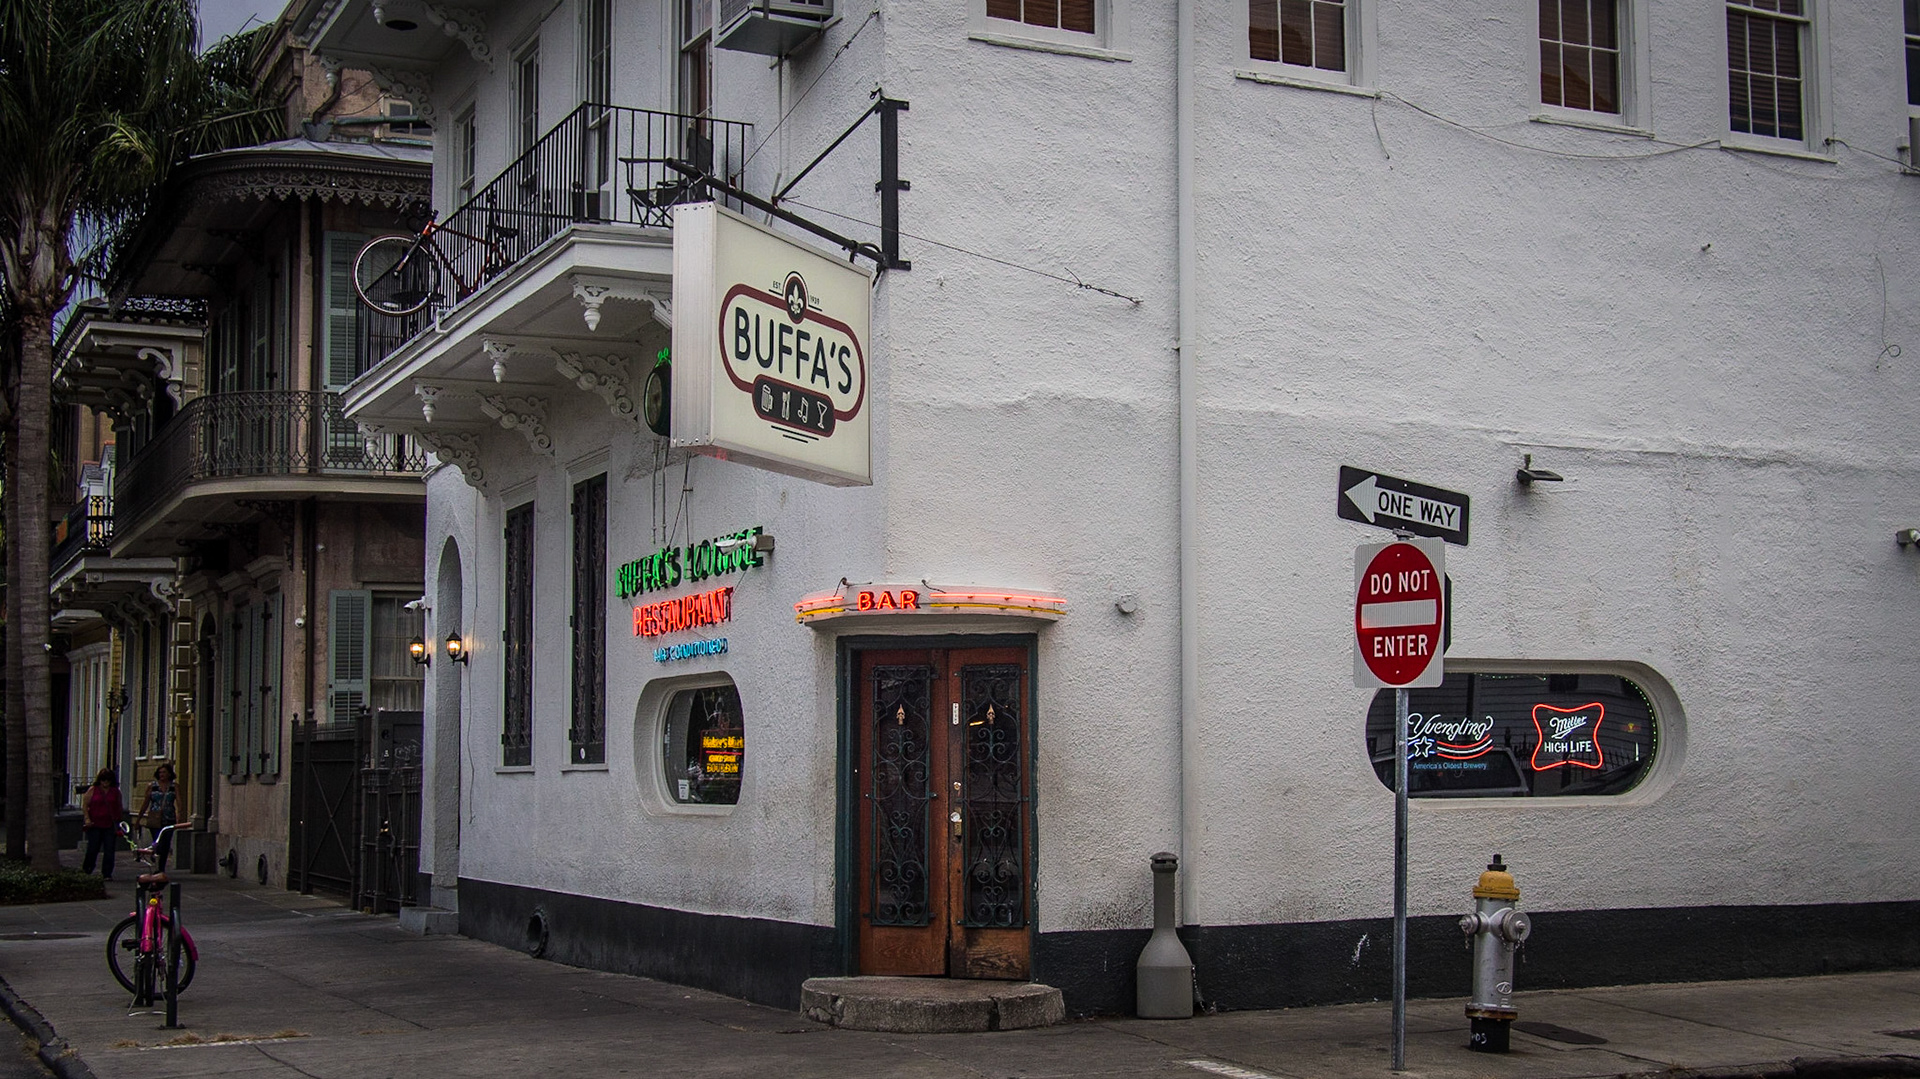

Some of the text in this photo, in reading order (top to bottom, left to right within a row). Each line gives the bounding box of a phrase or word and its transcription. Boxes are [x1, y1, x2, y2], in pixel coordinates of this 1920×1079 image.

[734, 306, 852, 394] BUFFA'S
[1378, 491, 1456, 527] ONE WAY
[615, 526, 763, 599] BUFFA'S LOUNGE
[1370, 569, 1430, 595] DO NOT
[633, 587, 734, 637] RESTAURANT
[857, 589, 920, 612] BAR
[1373, 634, 1428, 658] ENTER
[1407, 712, 1494, 741] Yuengling
[1549, 715, 1588, 738] Miller
[1544, 740, 1592, 753] HIGH LIFE
[1413, 762, 1442, 770] America's
[1463, 762, 1487, 770] Brewery
